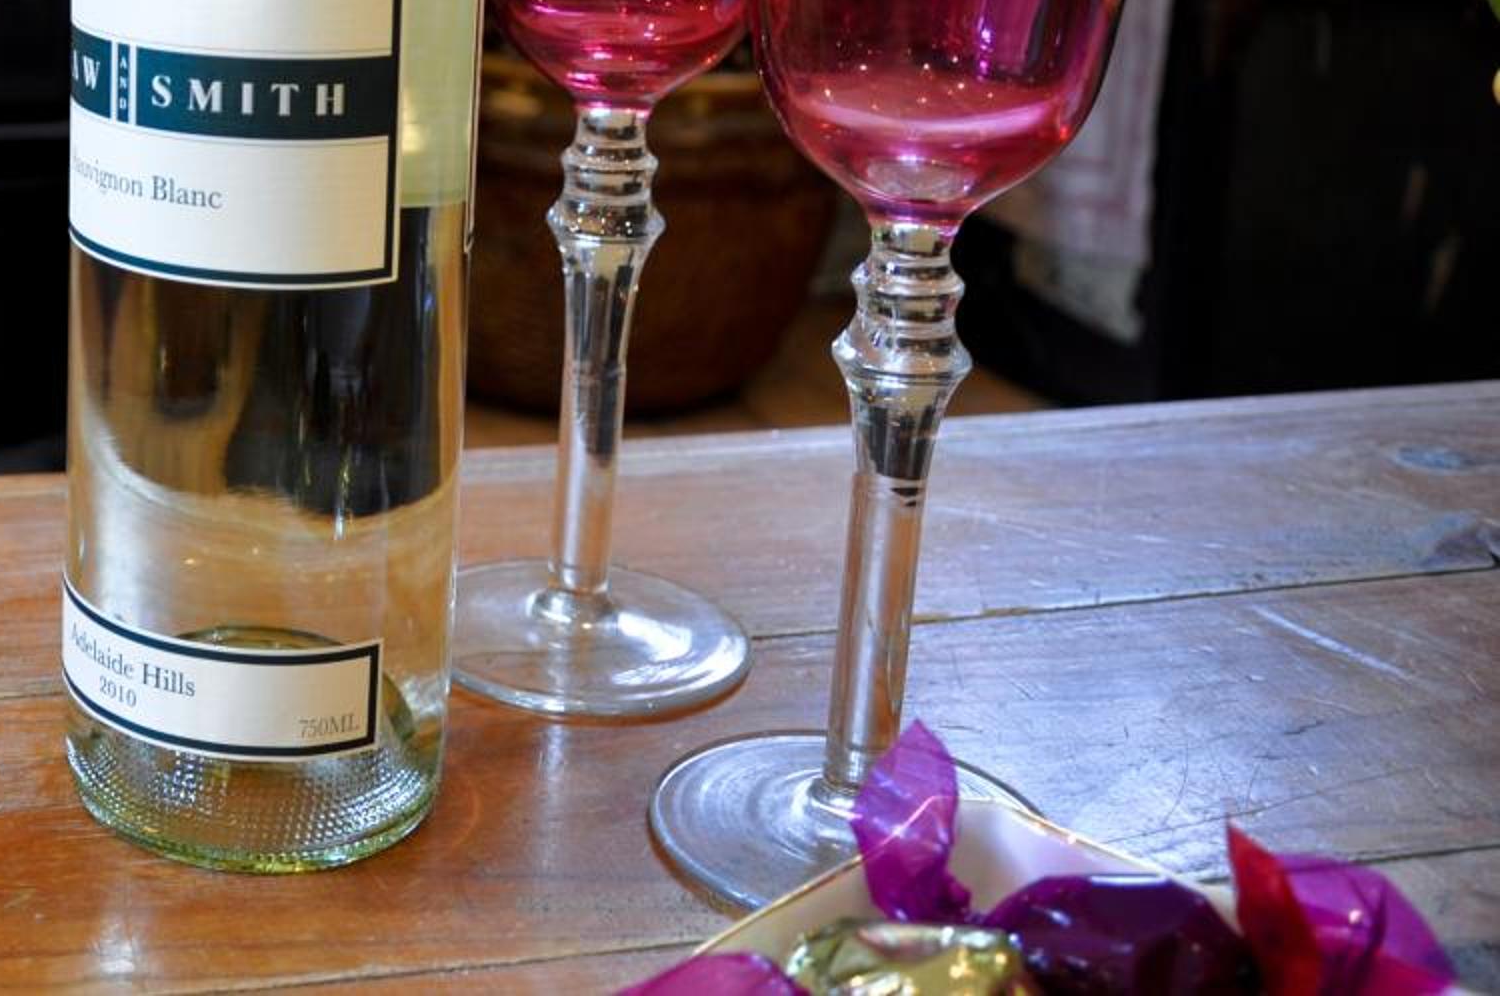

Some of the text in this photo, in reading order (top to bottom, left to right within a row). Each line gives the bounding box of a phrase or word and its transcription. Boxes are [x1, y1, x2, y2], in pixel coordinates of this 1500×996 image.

[118, 55, 128, 110] AND
[150, 74, 346, 117] SMITH
[151, 174, 224, 210] Blanc
[70, 622, 196, 698] Adelaide Hills
[99, 675, 138, 708] 2010
[298, 713, 361, 739] 750ML
